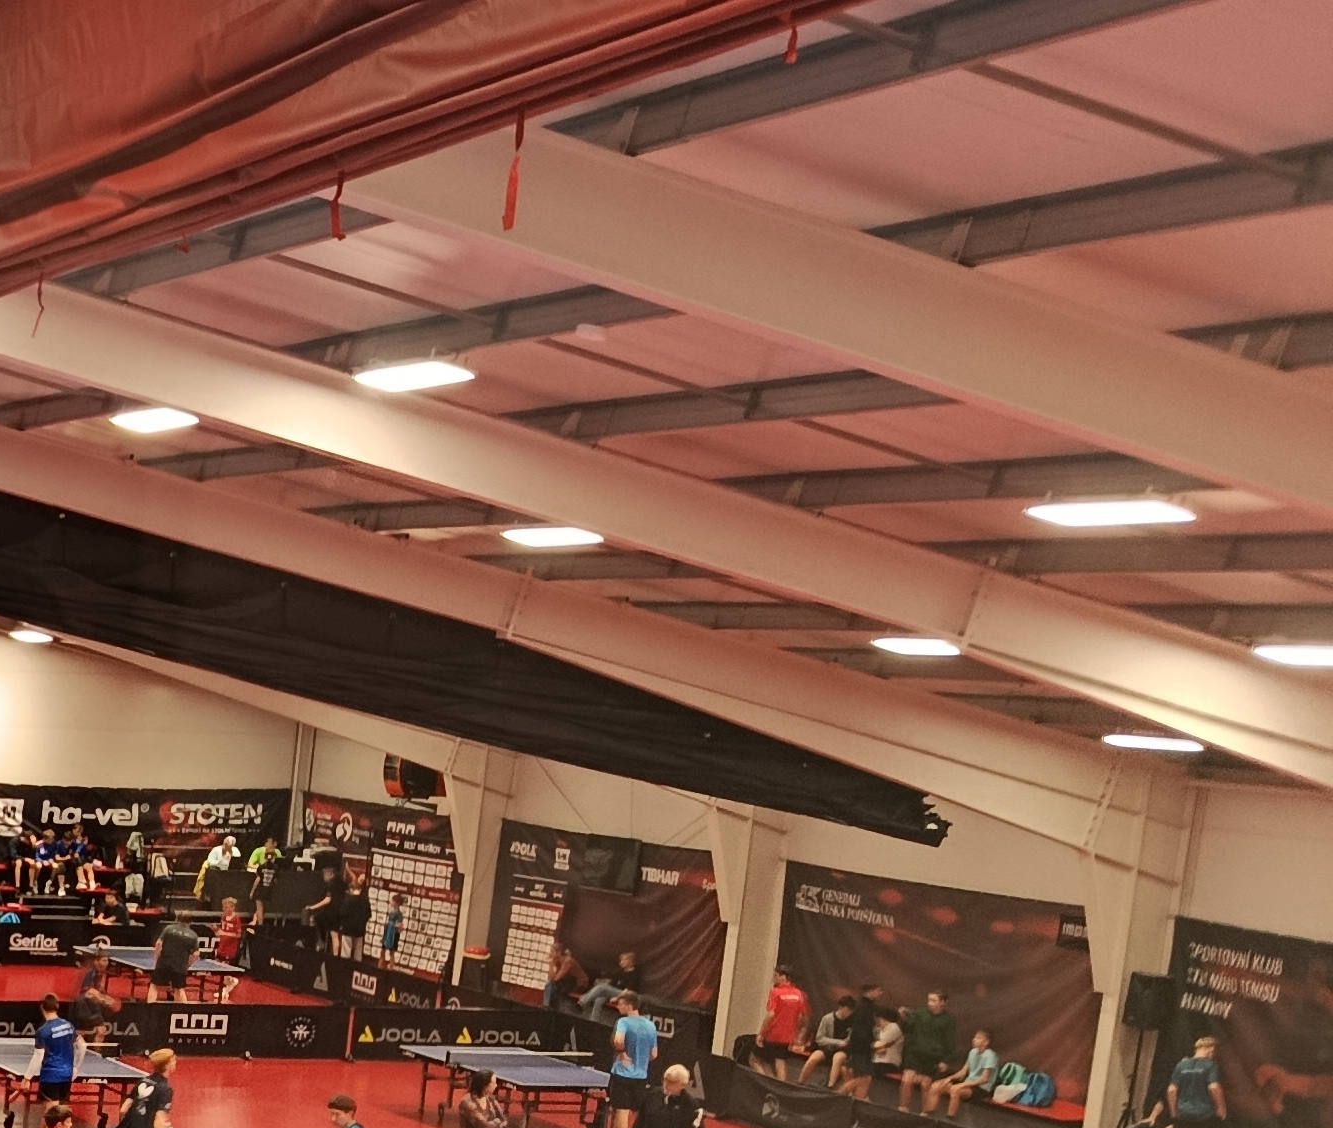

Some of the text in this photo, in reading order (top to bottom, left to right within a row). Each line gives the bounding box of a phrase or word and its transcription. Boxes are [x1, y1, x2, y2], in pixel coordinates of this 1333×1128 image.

[41, 800, 139, 826] ha-vel
[169, 803, 263, 825] STOTEN
[641, 867, 681, 886] TIBHAR
[9, 932, 59, 950] Gerflor
[1189, 942, 1283, 976] SPORTOVNÍ KLUB
[1239, 978, 1281, 1004] TENISU
[375, 1027, 443, 1044] JOOLA
[472, 1029, 541, 1046] JOOLA
